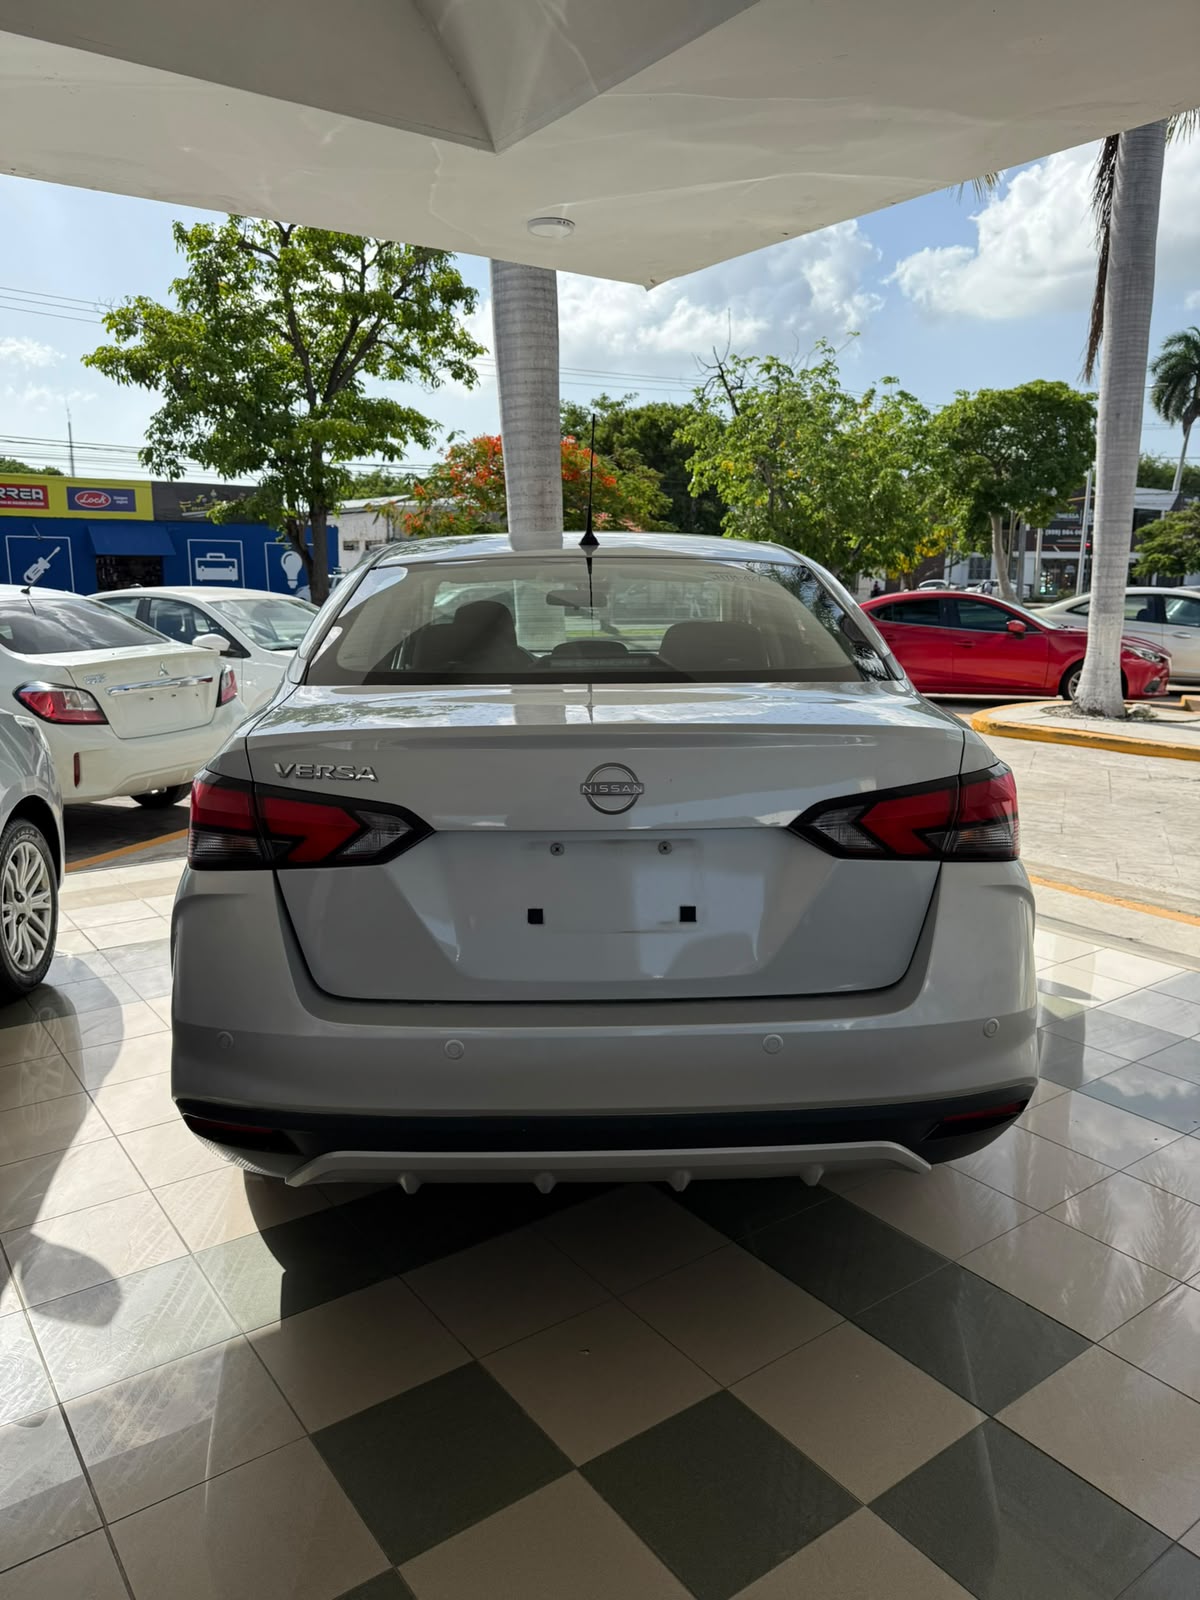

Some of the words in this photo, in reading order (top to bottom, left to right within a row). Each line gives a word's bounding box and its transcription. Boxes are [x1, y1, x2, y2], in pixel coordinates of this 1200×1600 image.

[79, 493, 107, 505] Lock
[274, 762, 379, 783] VERSA
[582, 784, 643, 793] NISSAN
